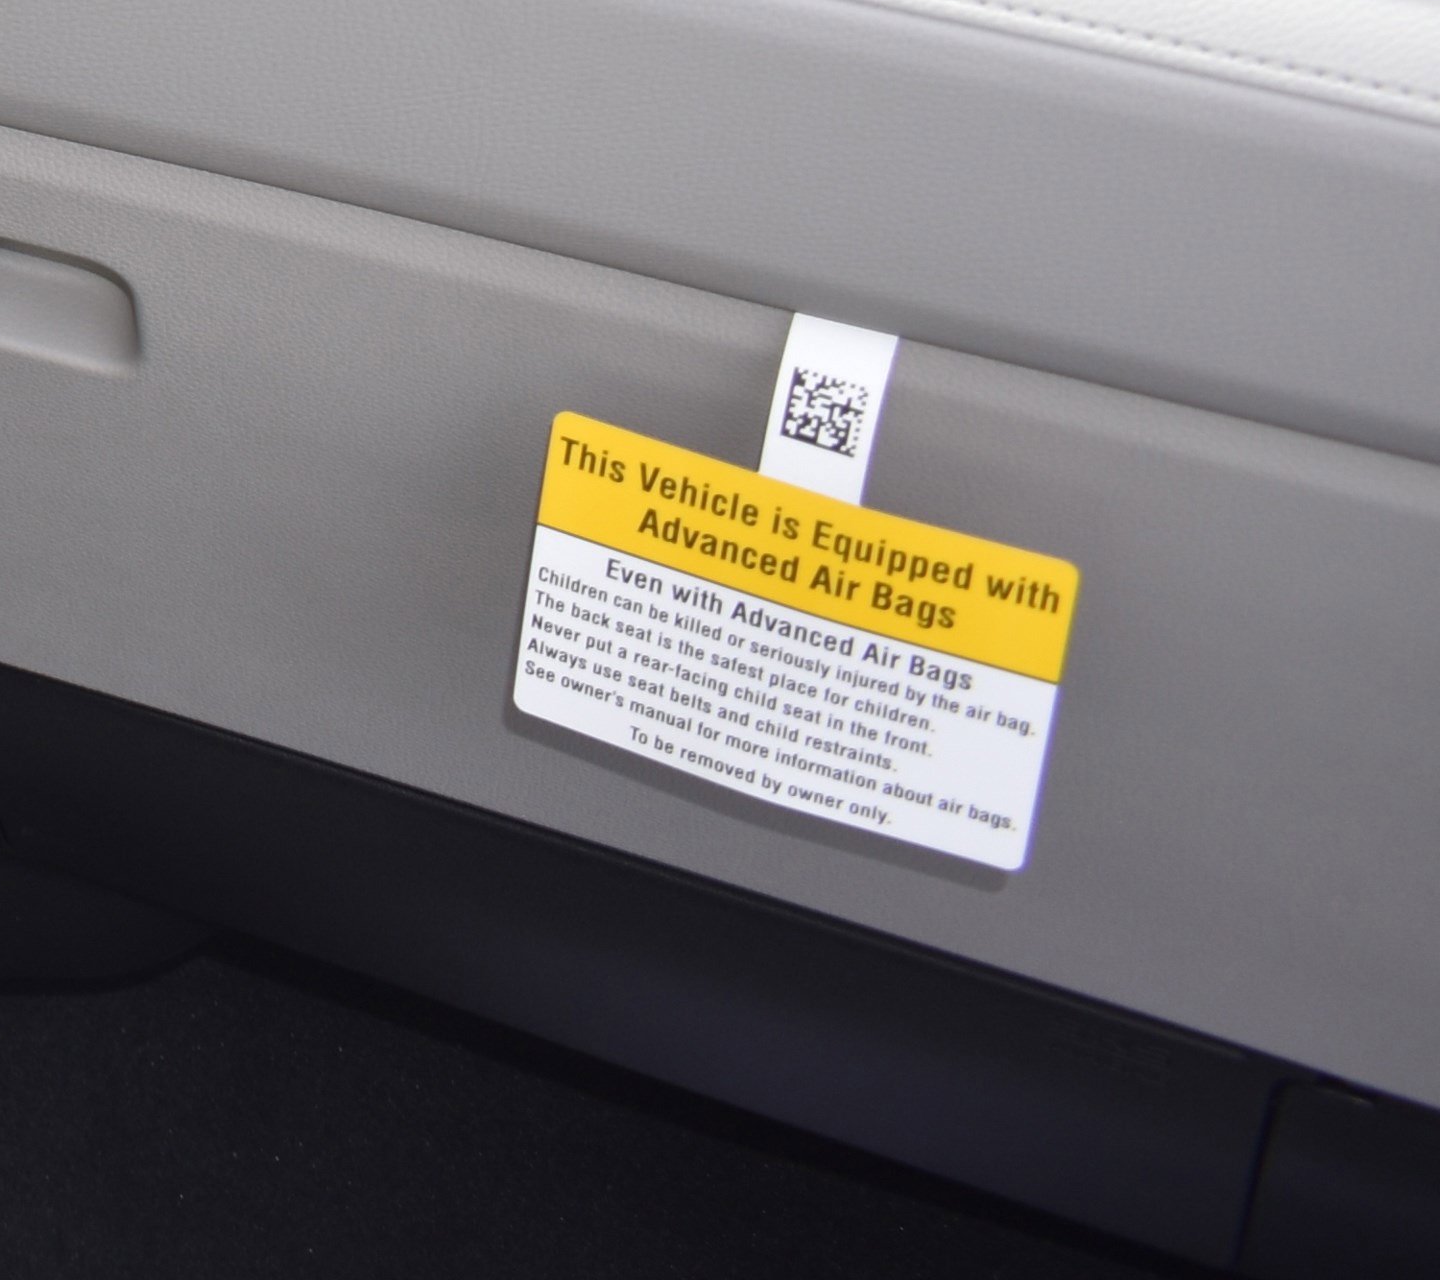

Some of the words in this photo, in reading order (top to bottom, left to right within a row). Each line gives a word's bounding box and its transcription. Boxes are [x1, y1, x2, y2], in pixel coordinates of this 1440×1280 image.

[559, 435, 626, 484] This
[639, 461, 759, 527] Vehicle
[771, 505, 800, 540] is
[811, 519, 974, 591] Equipped
[986, 574, 1060, 614] with
[636, 507, 800, 583] Advanced
[808, 563, 861, 601] Air
[870, 580, 956, 630] Bags
[530, 612, 581, 643] Never
[584, 634, 613, 655] put
[616, 645, 628, 660] a
[632, 651, 729, 697] rear-facing
[732, 686, 778, 711] child
[781, 702, 821, 725] seat
[825, 715, 844, 731] in
[849, 720, 878, 741] the
[883, 729, 933, 755] front.
[534, 588, 565, 613] The
[569, 601, 611, 629] back
[614, 619, 653, 644] seat
[656, 631, 672, 650] is
[677, 638, 705, 661] the
[709, 652, 764, 681] safest
[767, 672, 818, 698] place
[822, 686, 850, 707] for
[853, 698, 935, 731] children.
[537, 565, 608, 603] Children
[612, 594, 643, 615] can
[647, 602, 669, 624] be
[673, 611, 723, 642] killed
[726, 632, 746, 649] or
[748, 640, 831, 679] seriously
[834, 667, 900, 697] injured
[903, 684, 927, 707] by
[930, 692, 960, 714] the
[964, 704, 992, 722] air
[995, 710, 1035, 737] bag.
[604, 556, 663, 595] Even
[671, 583, 723, 615] with
[729, 600, 854, 657] Advanced
[860, 641, 901, 669] Air
[907, 653, 973, 691] Bags
[523, 658, 556, 683] See
[559, 675, 624, 708] owner's
[628, 699, 692, 732] manual
[696, 720, 721, 742] for
[724, 733, 770, 759] more
[773, 750, 877, 791] information
[881, 781, 933, 807] about
[936, 797, 963, 814] air
[967, 803, 1016, 830] bags.
[525, 636, 587, 670] Always
[591, 661, 623, 683] use
[627, 674, 665, 698] seat
[668, 685, 712, 714] belts
[716, 705, 750, 727] and
[754, 718, 800, 743] child
[803, 734, 897, 770] restraints.
[629, 724, 649, 745] To
[652, 733, 675, 755] be
[678, 747, 756, 784] removed
[760, 772, 782, 795] by
[786, 783, 844, 810] owner
[847, 801, 893, 825] only.
